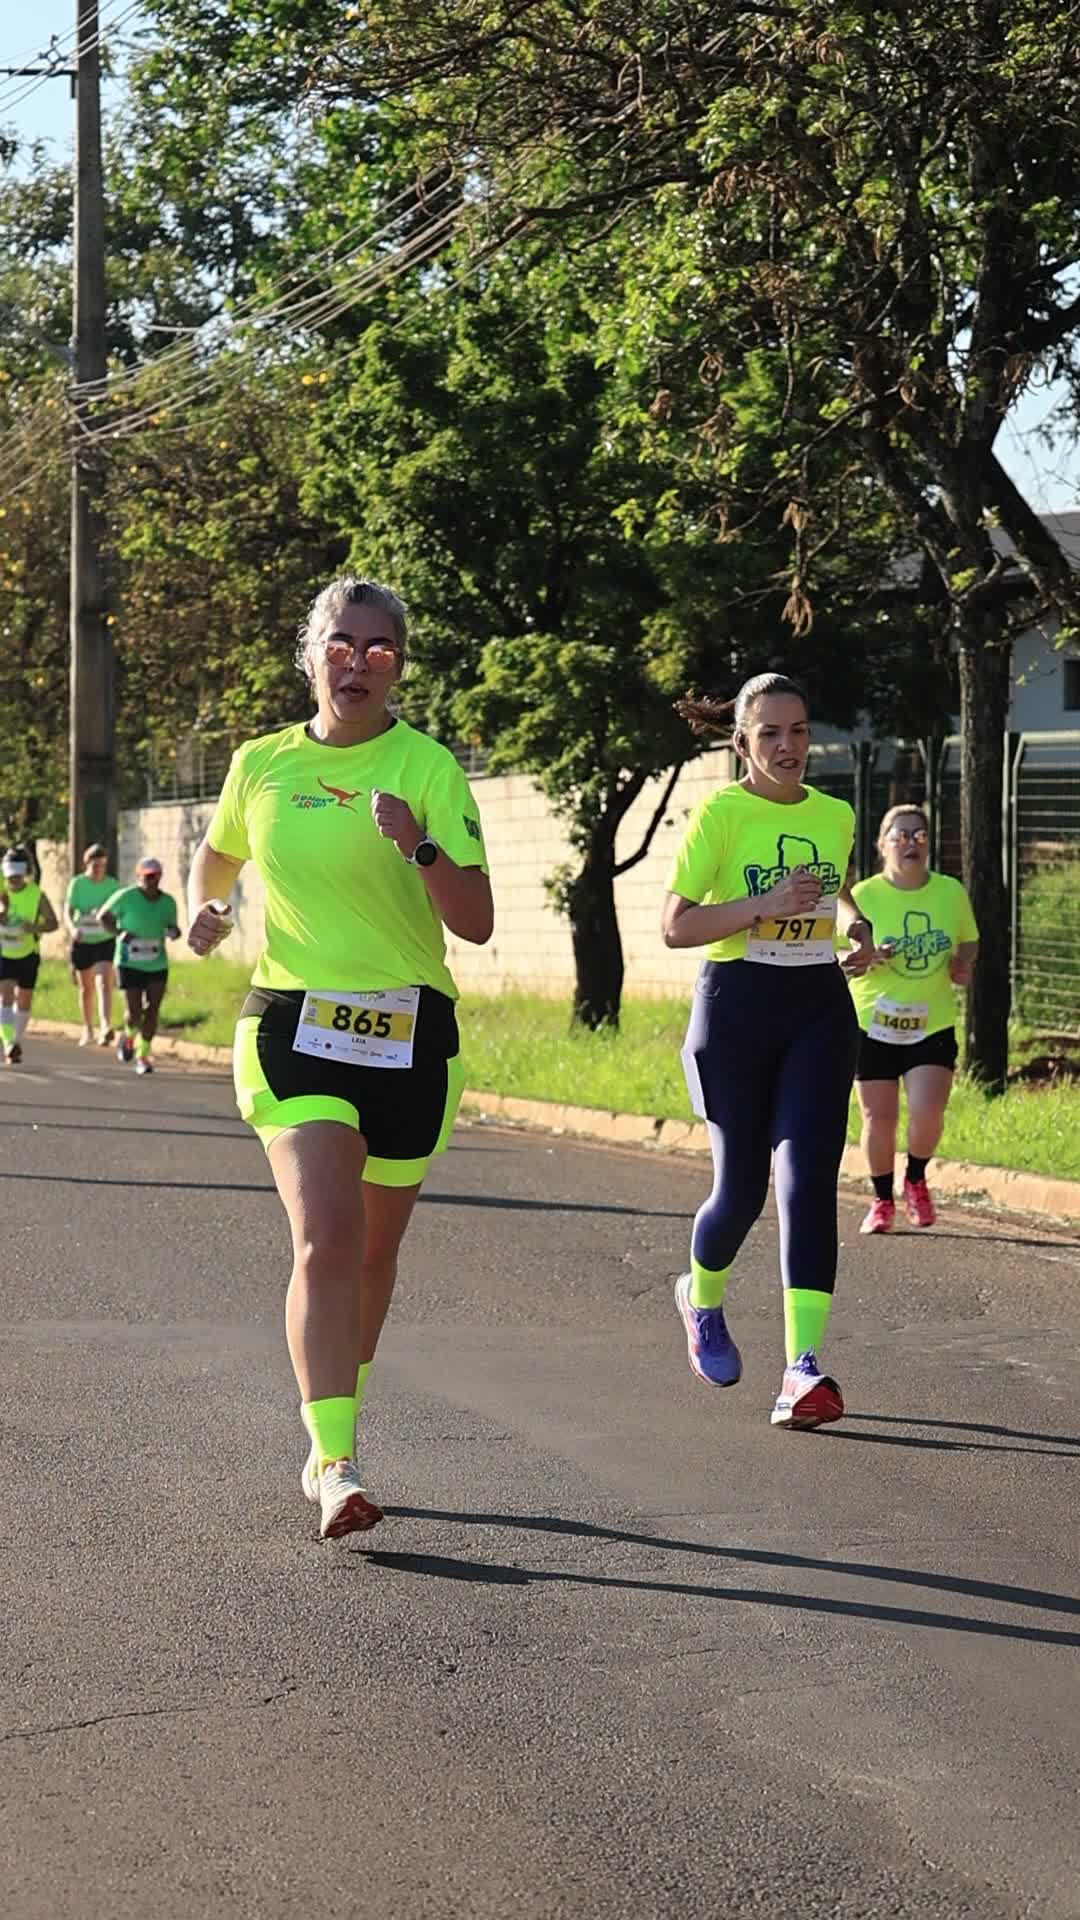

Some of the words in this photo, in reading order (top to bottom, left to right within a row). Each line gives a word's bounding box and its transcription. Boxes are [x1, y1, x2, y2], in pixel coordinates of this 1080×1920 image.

[774, 919, 816, 940] 797
[332, 1004, 393, 1038] 865
[883, 1014, 920, 1030] 1403
